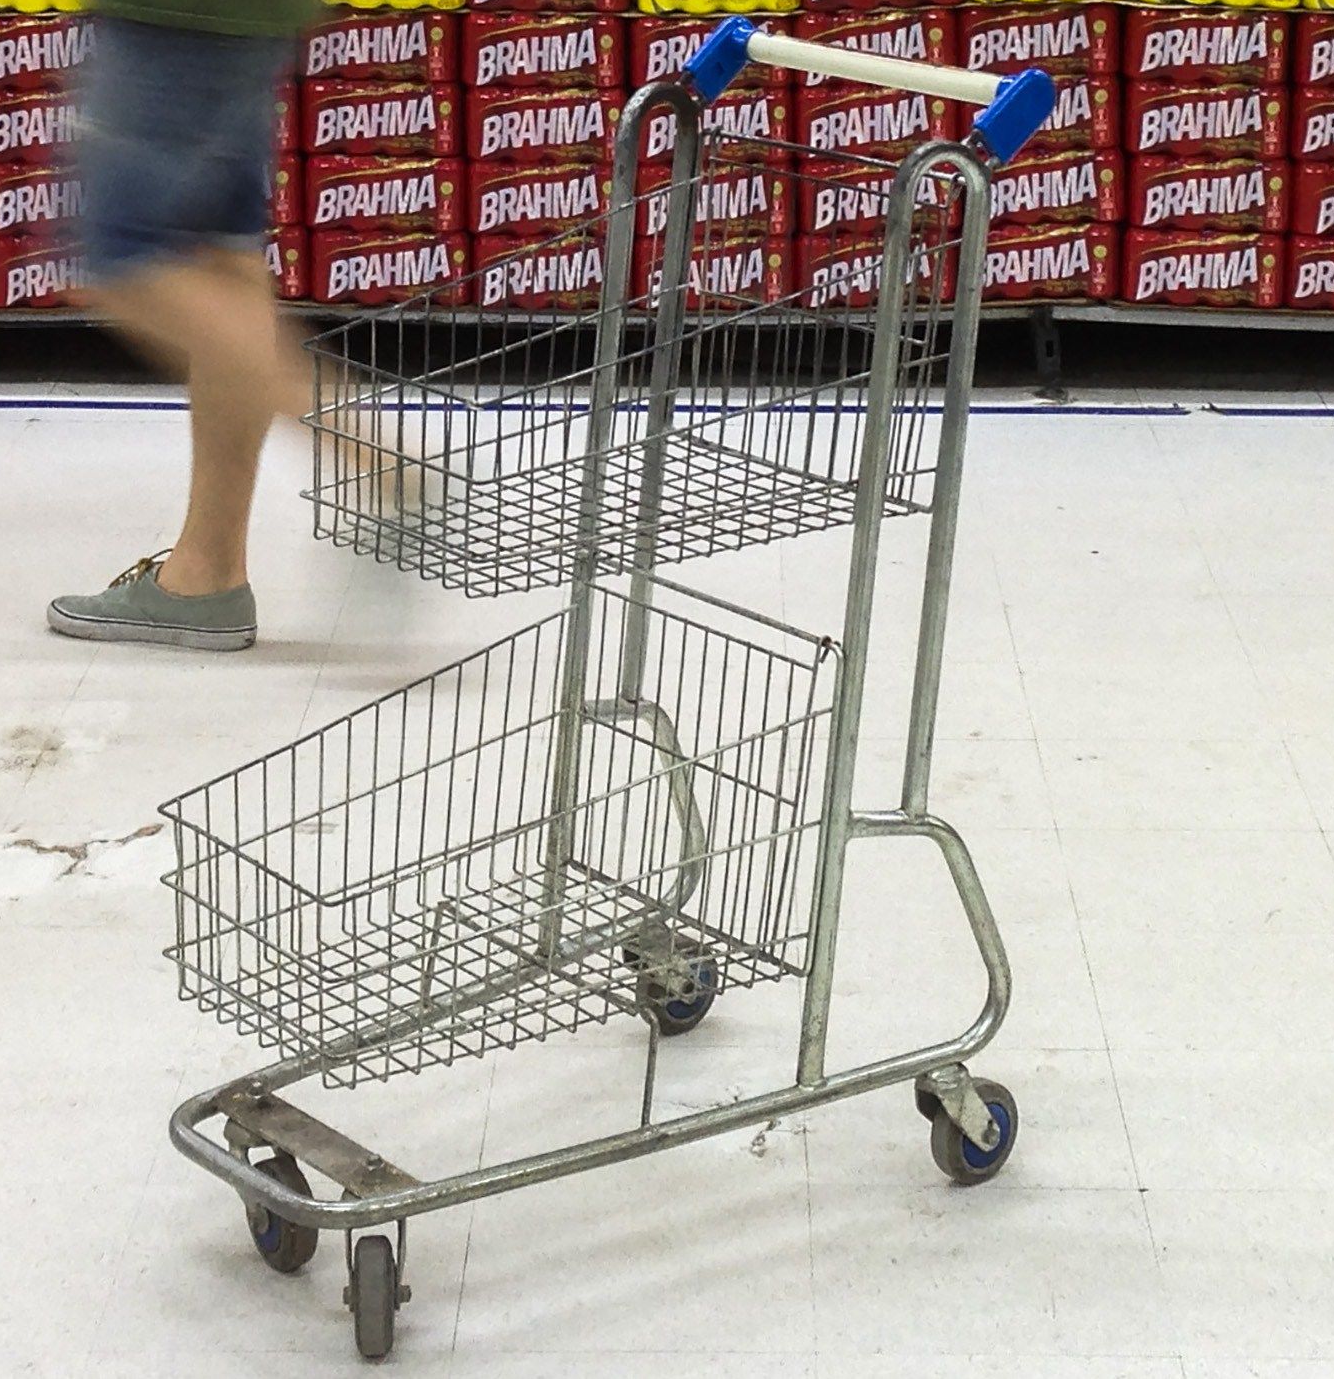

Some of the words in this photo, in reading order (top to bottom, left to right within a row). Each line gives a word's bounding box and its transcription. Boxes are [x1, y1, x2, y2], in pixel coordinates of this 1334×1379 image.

[307, 21, 426, 75] BRAHMA
[1140, 95, 1262, 149] BRAHMA
[328, 244, 450, 298] BRAHMA
